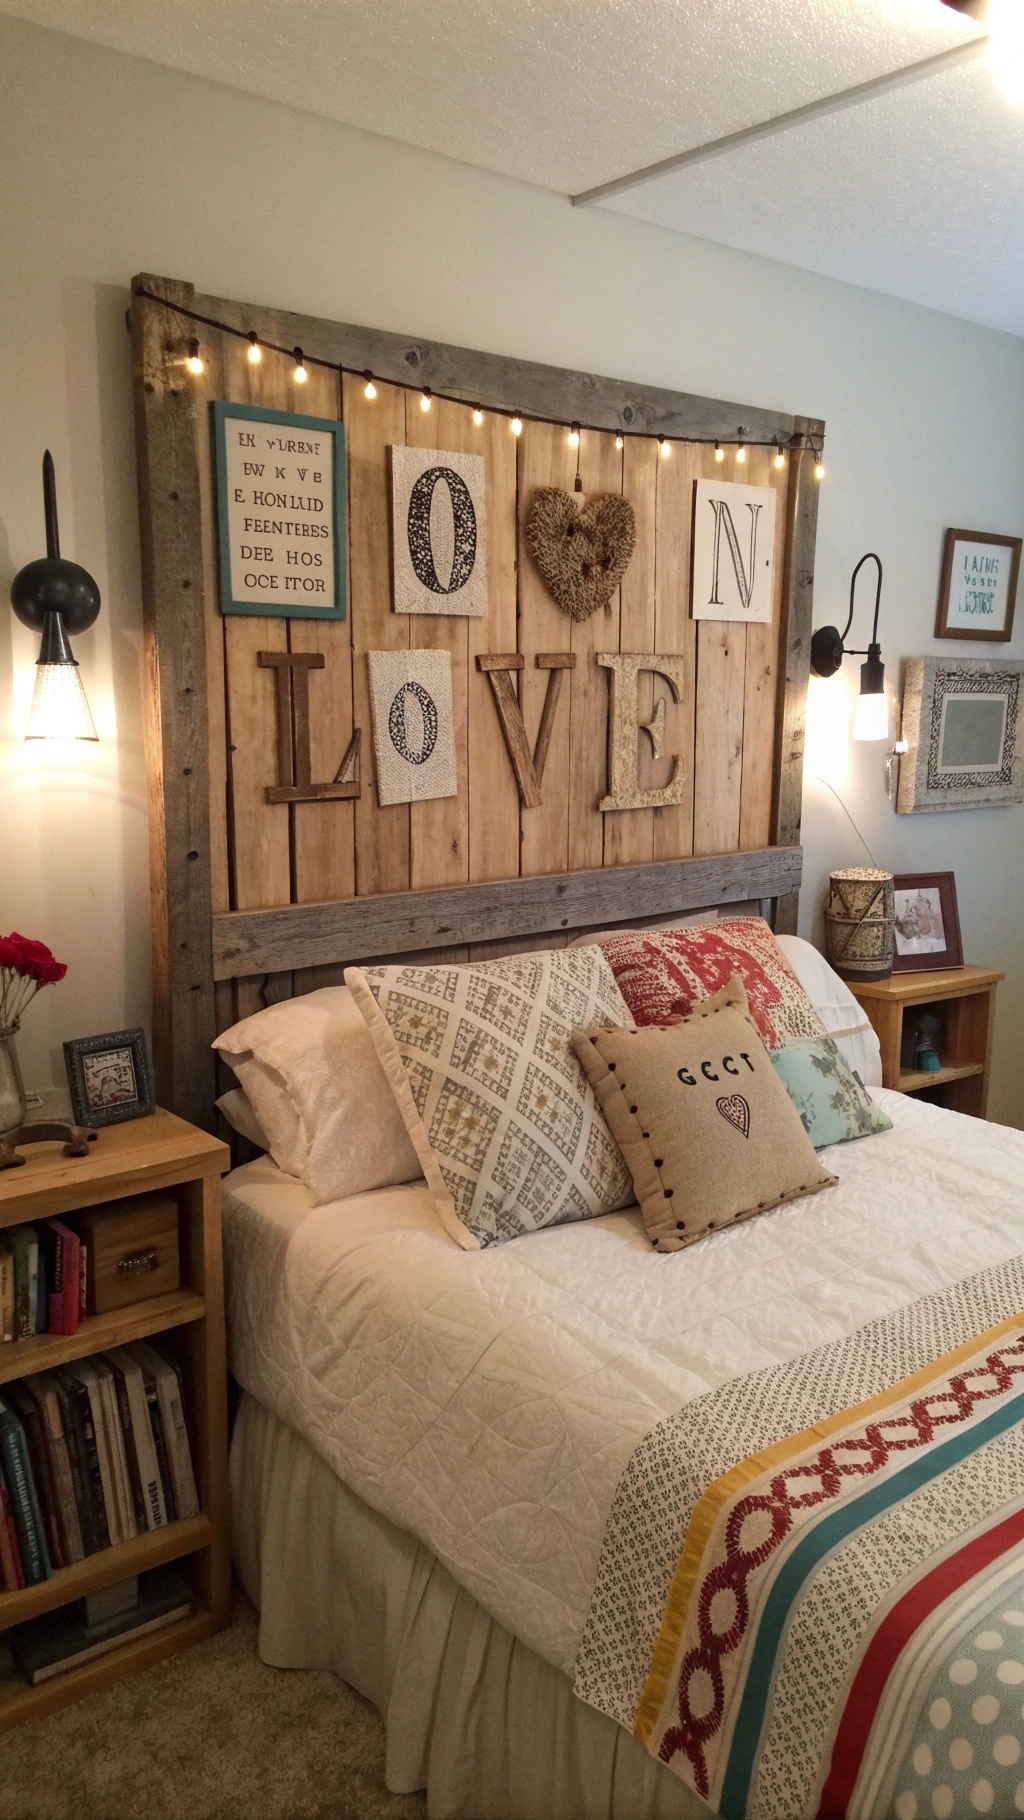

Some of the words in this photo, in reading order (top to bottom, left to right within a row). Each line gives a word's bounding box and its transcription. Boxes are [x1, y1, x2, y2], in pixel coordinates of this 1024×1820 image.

[286, 550, 323, 567] HOS
[707, 499, 763, 609] N
[244, 573, 278, 589] OCE
